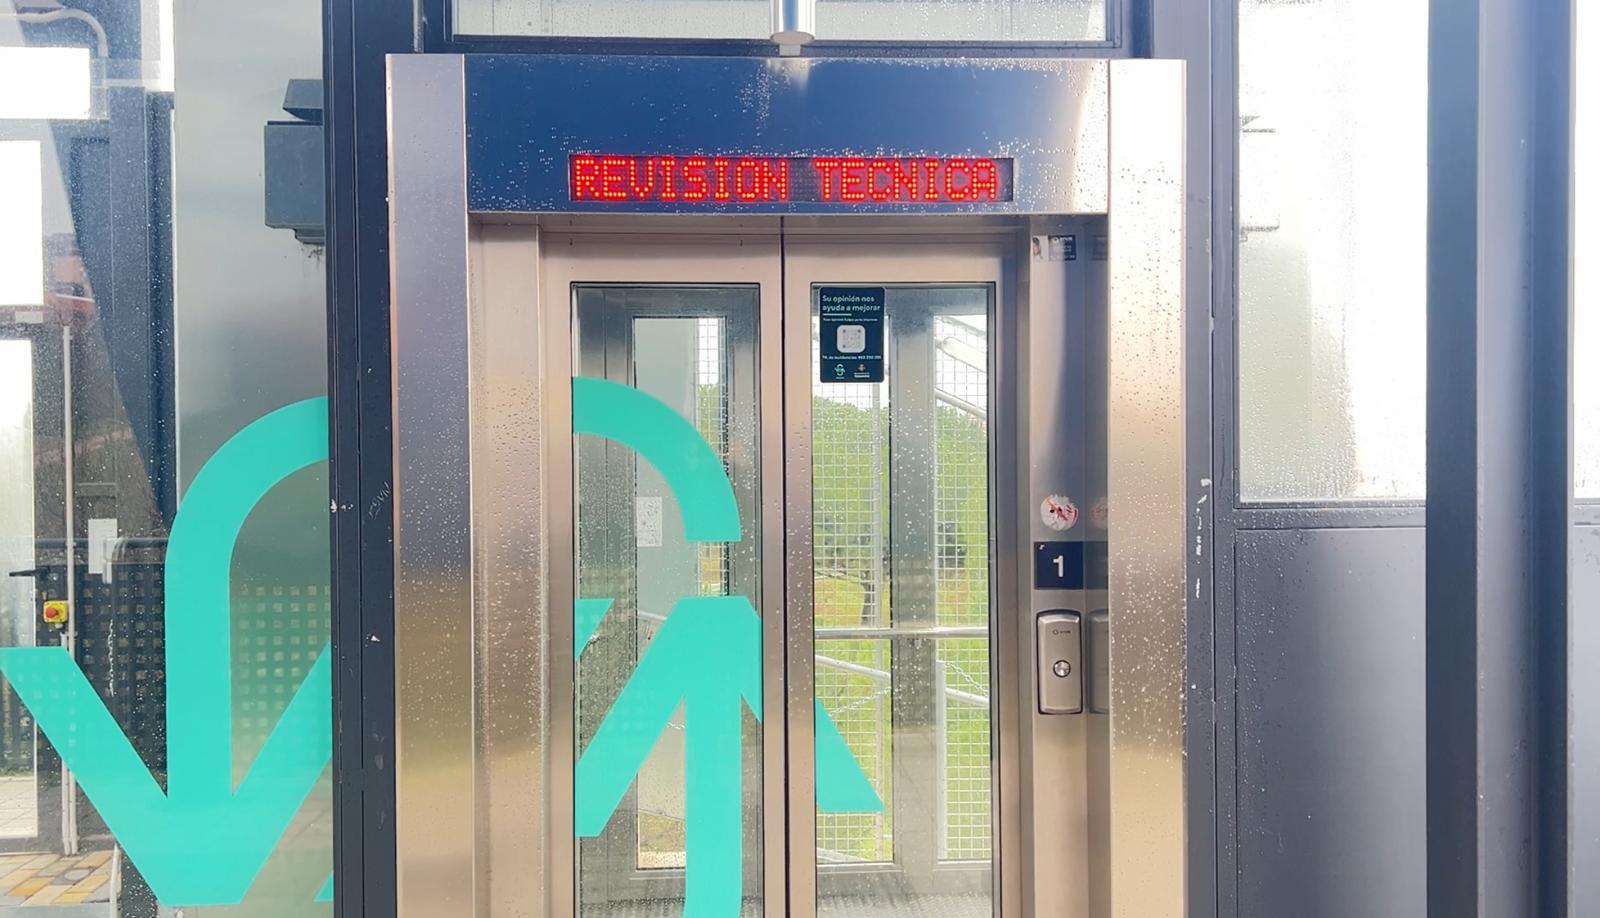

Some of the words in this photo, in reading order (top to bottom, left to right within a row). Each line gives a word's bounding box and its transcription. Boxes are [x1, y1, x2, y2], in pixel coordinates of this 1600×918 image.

[575, 158, 788, 201] REVISION
[815, 160, 997, 201] TECNICA
[833, 295, 860, 303] opinión
[852, 304, 881, 313] mejorar
[1052, 555, 1064, 578] 1
